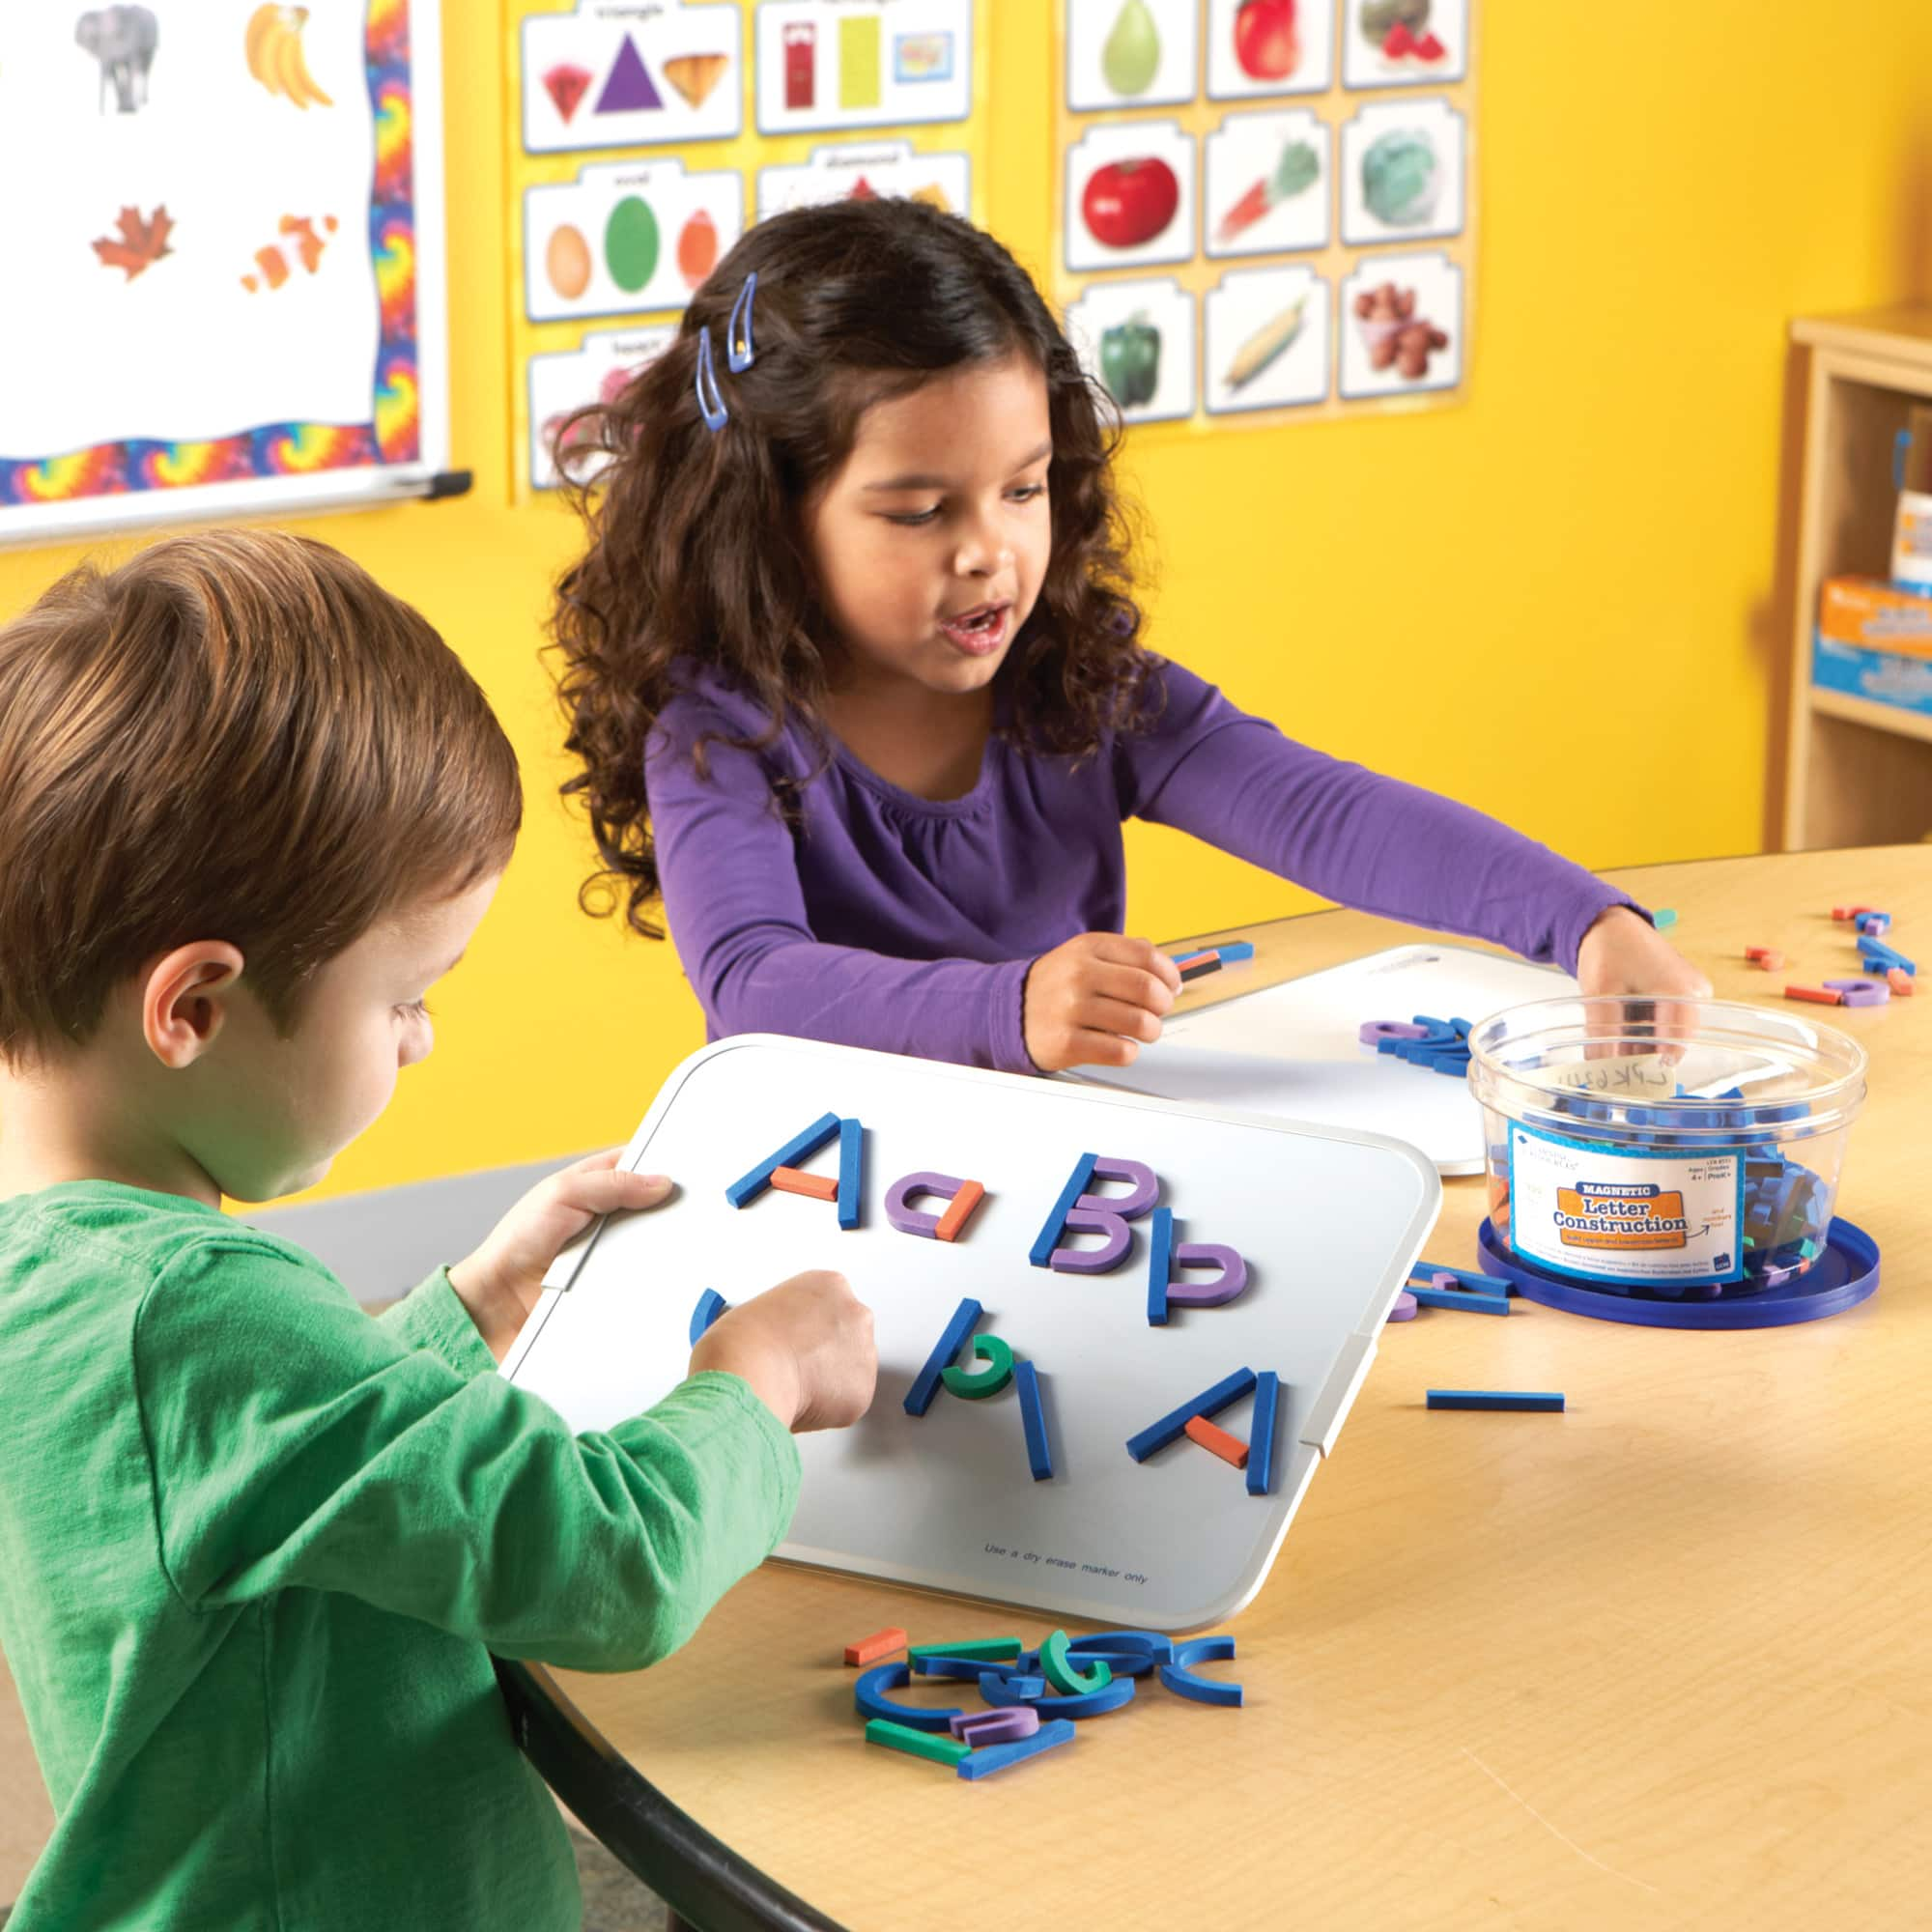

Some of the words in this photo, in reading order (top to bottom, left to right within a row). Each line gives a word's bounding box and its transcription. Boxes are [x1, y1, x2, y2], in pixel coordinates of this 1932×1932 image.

[1582, 1184, 1651, 1197] MAGNETIC
[1583, 1199, 1650, 1216] Letter
[1553, 1211, 1688, 1233] Construction
[984, 1543, 1007, 1556] Use
[1023, 1550, 1042, 1564] dry
[1045, 1557, 1077, 1570] erase
[1081, 1563, 1120, 1577] marker
[1123, 1573, 1150, 1585] only
